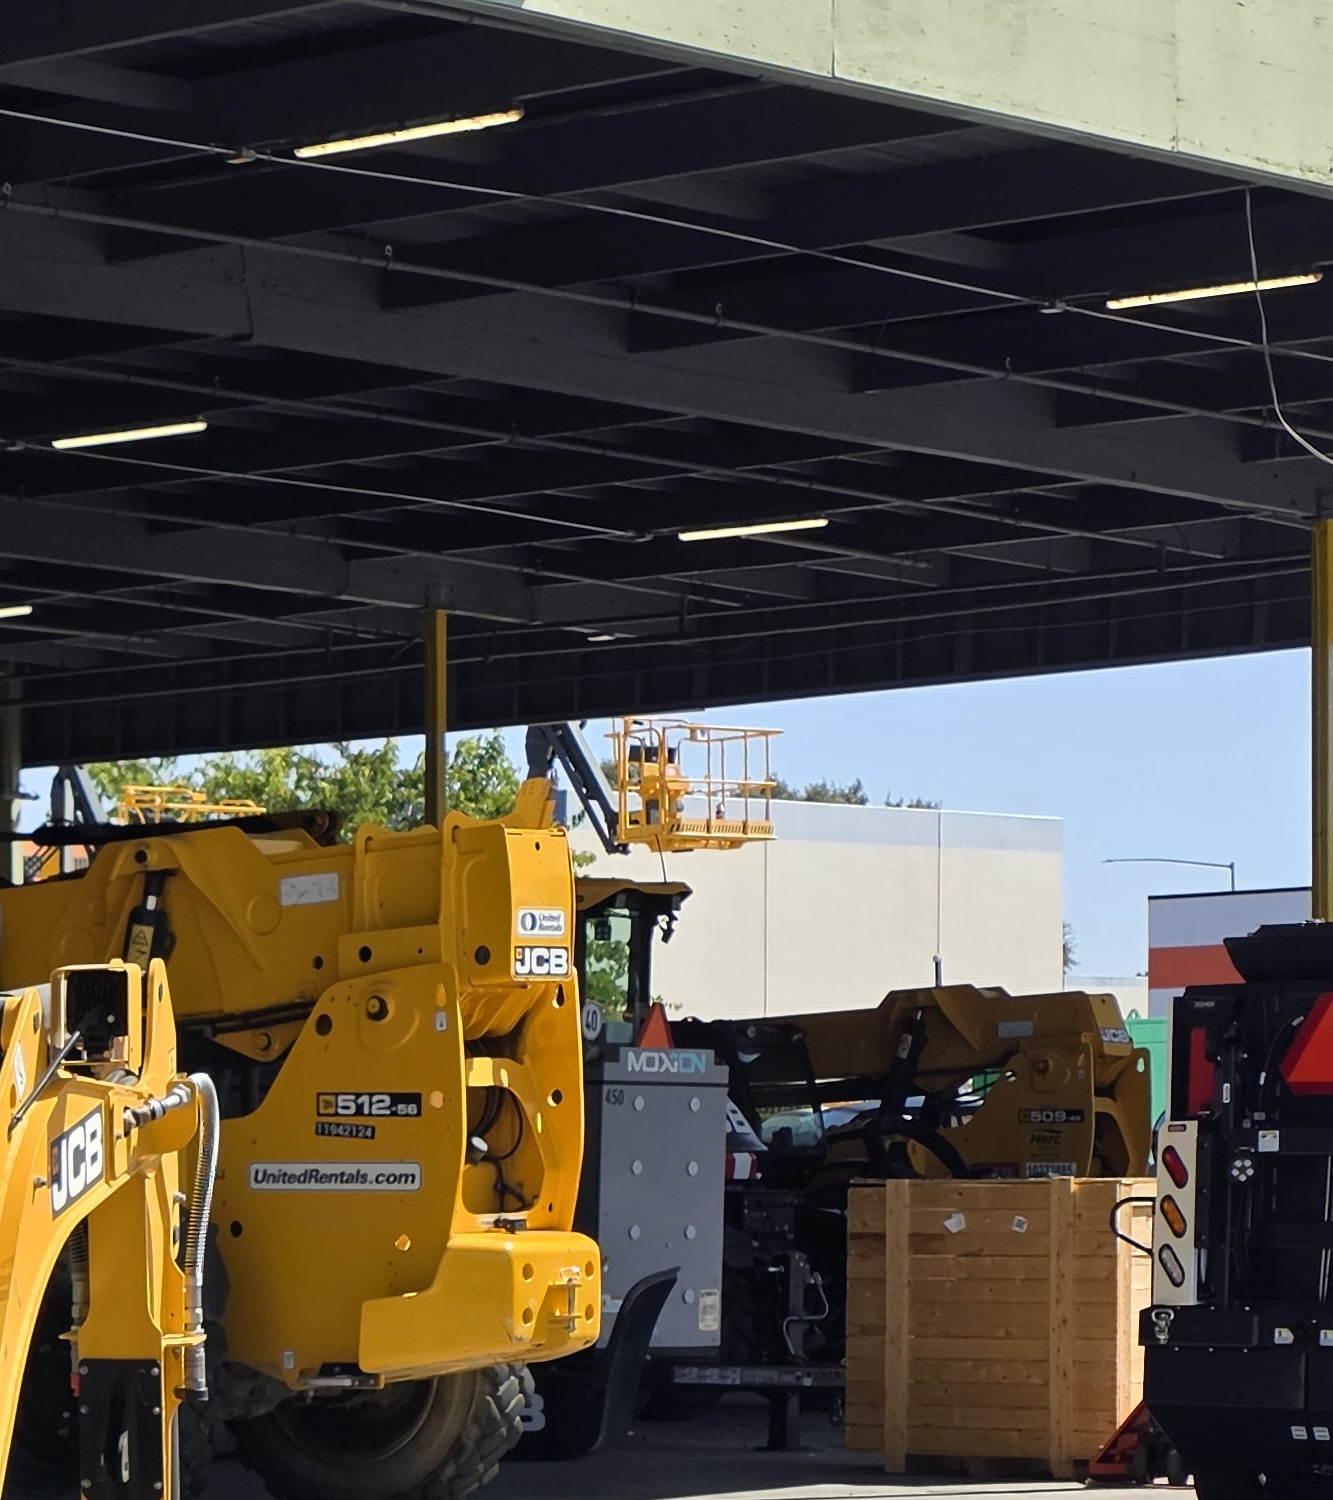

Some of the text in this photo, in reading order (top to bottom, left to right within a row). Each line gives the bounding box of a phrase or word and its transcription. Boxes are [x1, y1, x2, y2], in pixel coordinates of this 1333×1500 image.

[515, 948, 568, 974] JCB
[585, 1010, 597, 1032] 40
[1101, 1029, 1130, 1042] JCB
[627, 1051, 706, 1074] MOXION
[605, 1089, 625, 1106] 450
[52, 1113, 103, 1211] JCB
[253, 1168, 417, 1186] UnitedRentals.com
